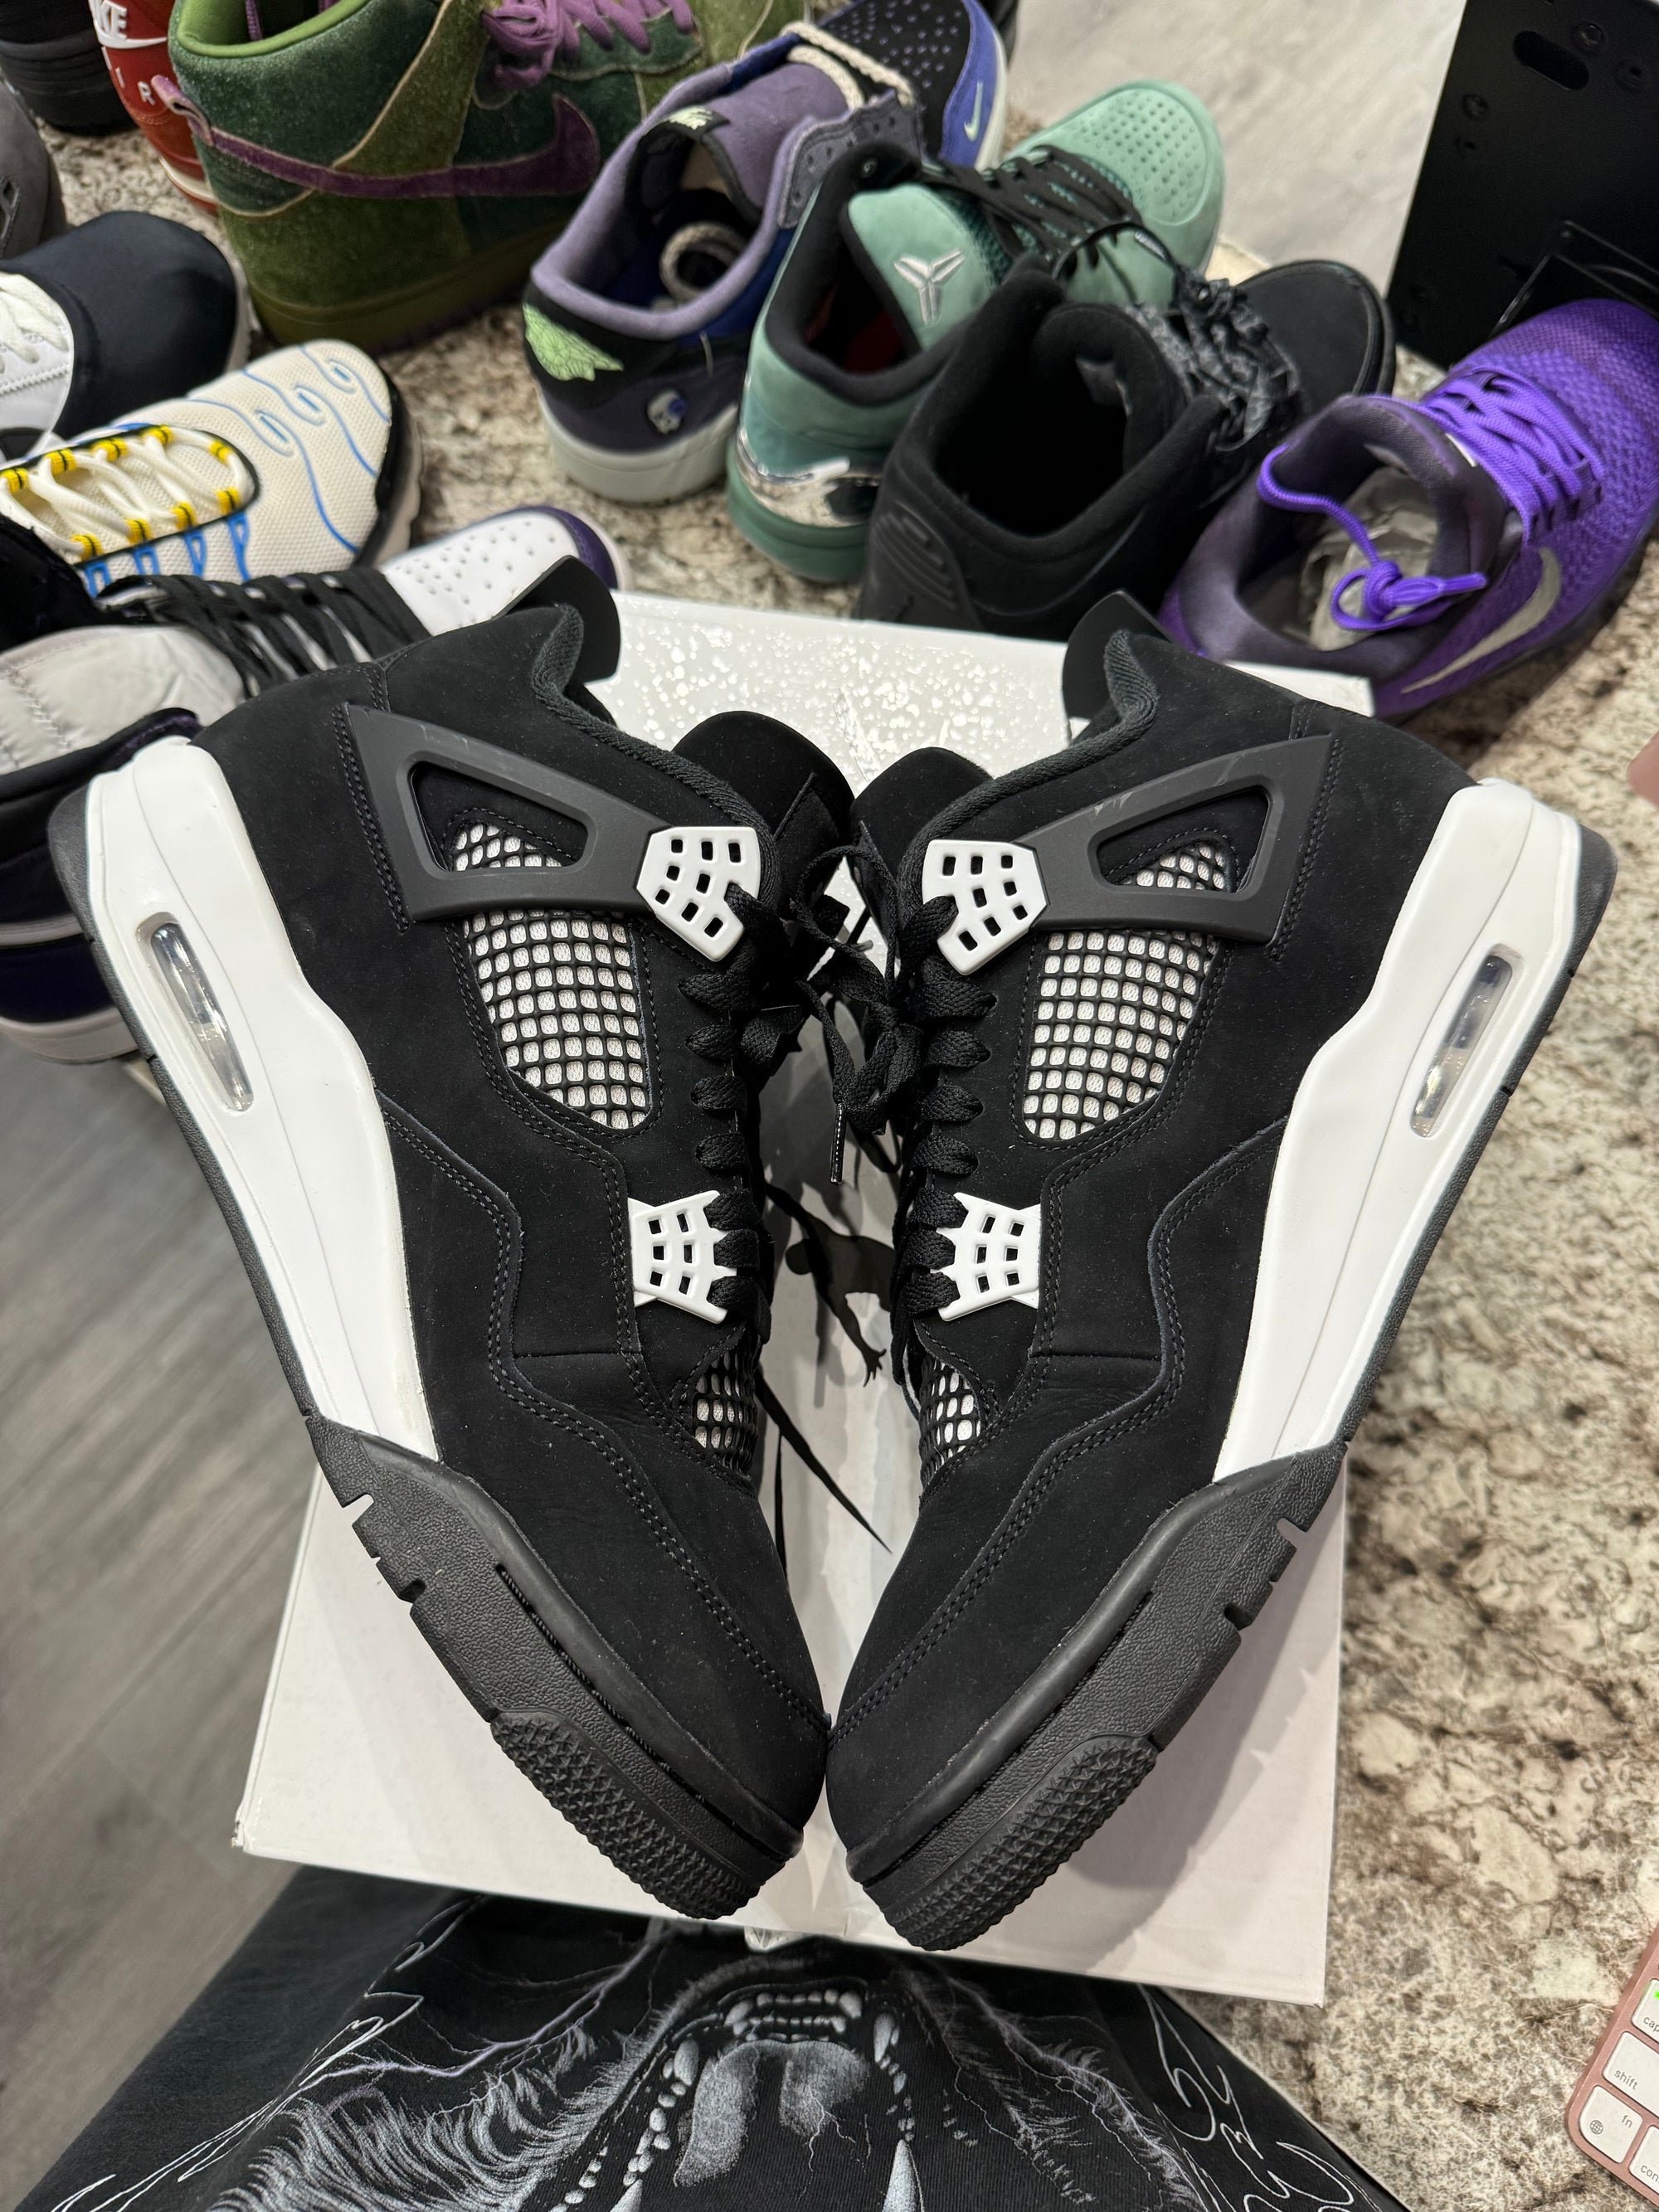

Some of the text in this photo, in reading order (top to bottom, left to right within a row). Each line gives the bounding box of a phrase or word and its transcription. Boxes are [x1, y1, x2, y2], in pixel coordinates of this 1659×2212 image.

[1614, 2069, 1638, 2091] shift
[1621, 2115, 1632, 2128] fn
[1640, 2165, 1659, 2184] con
